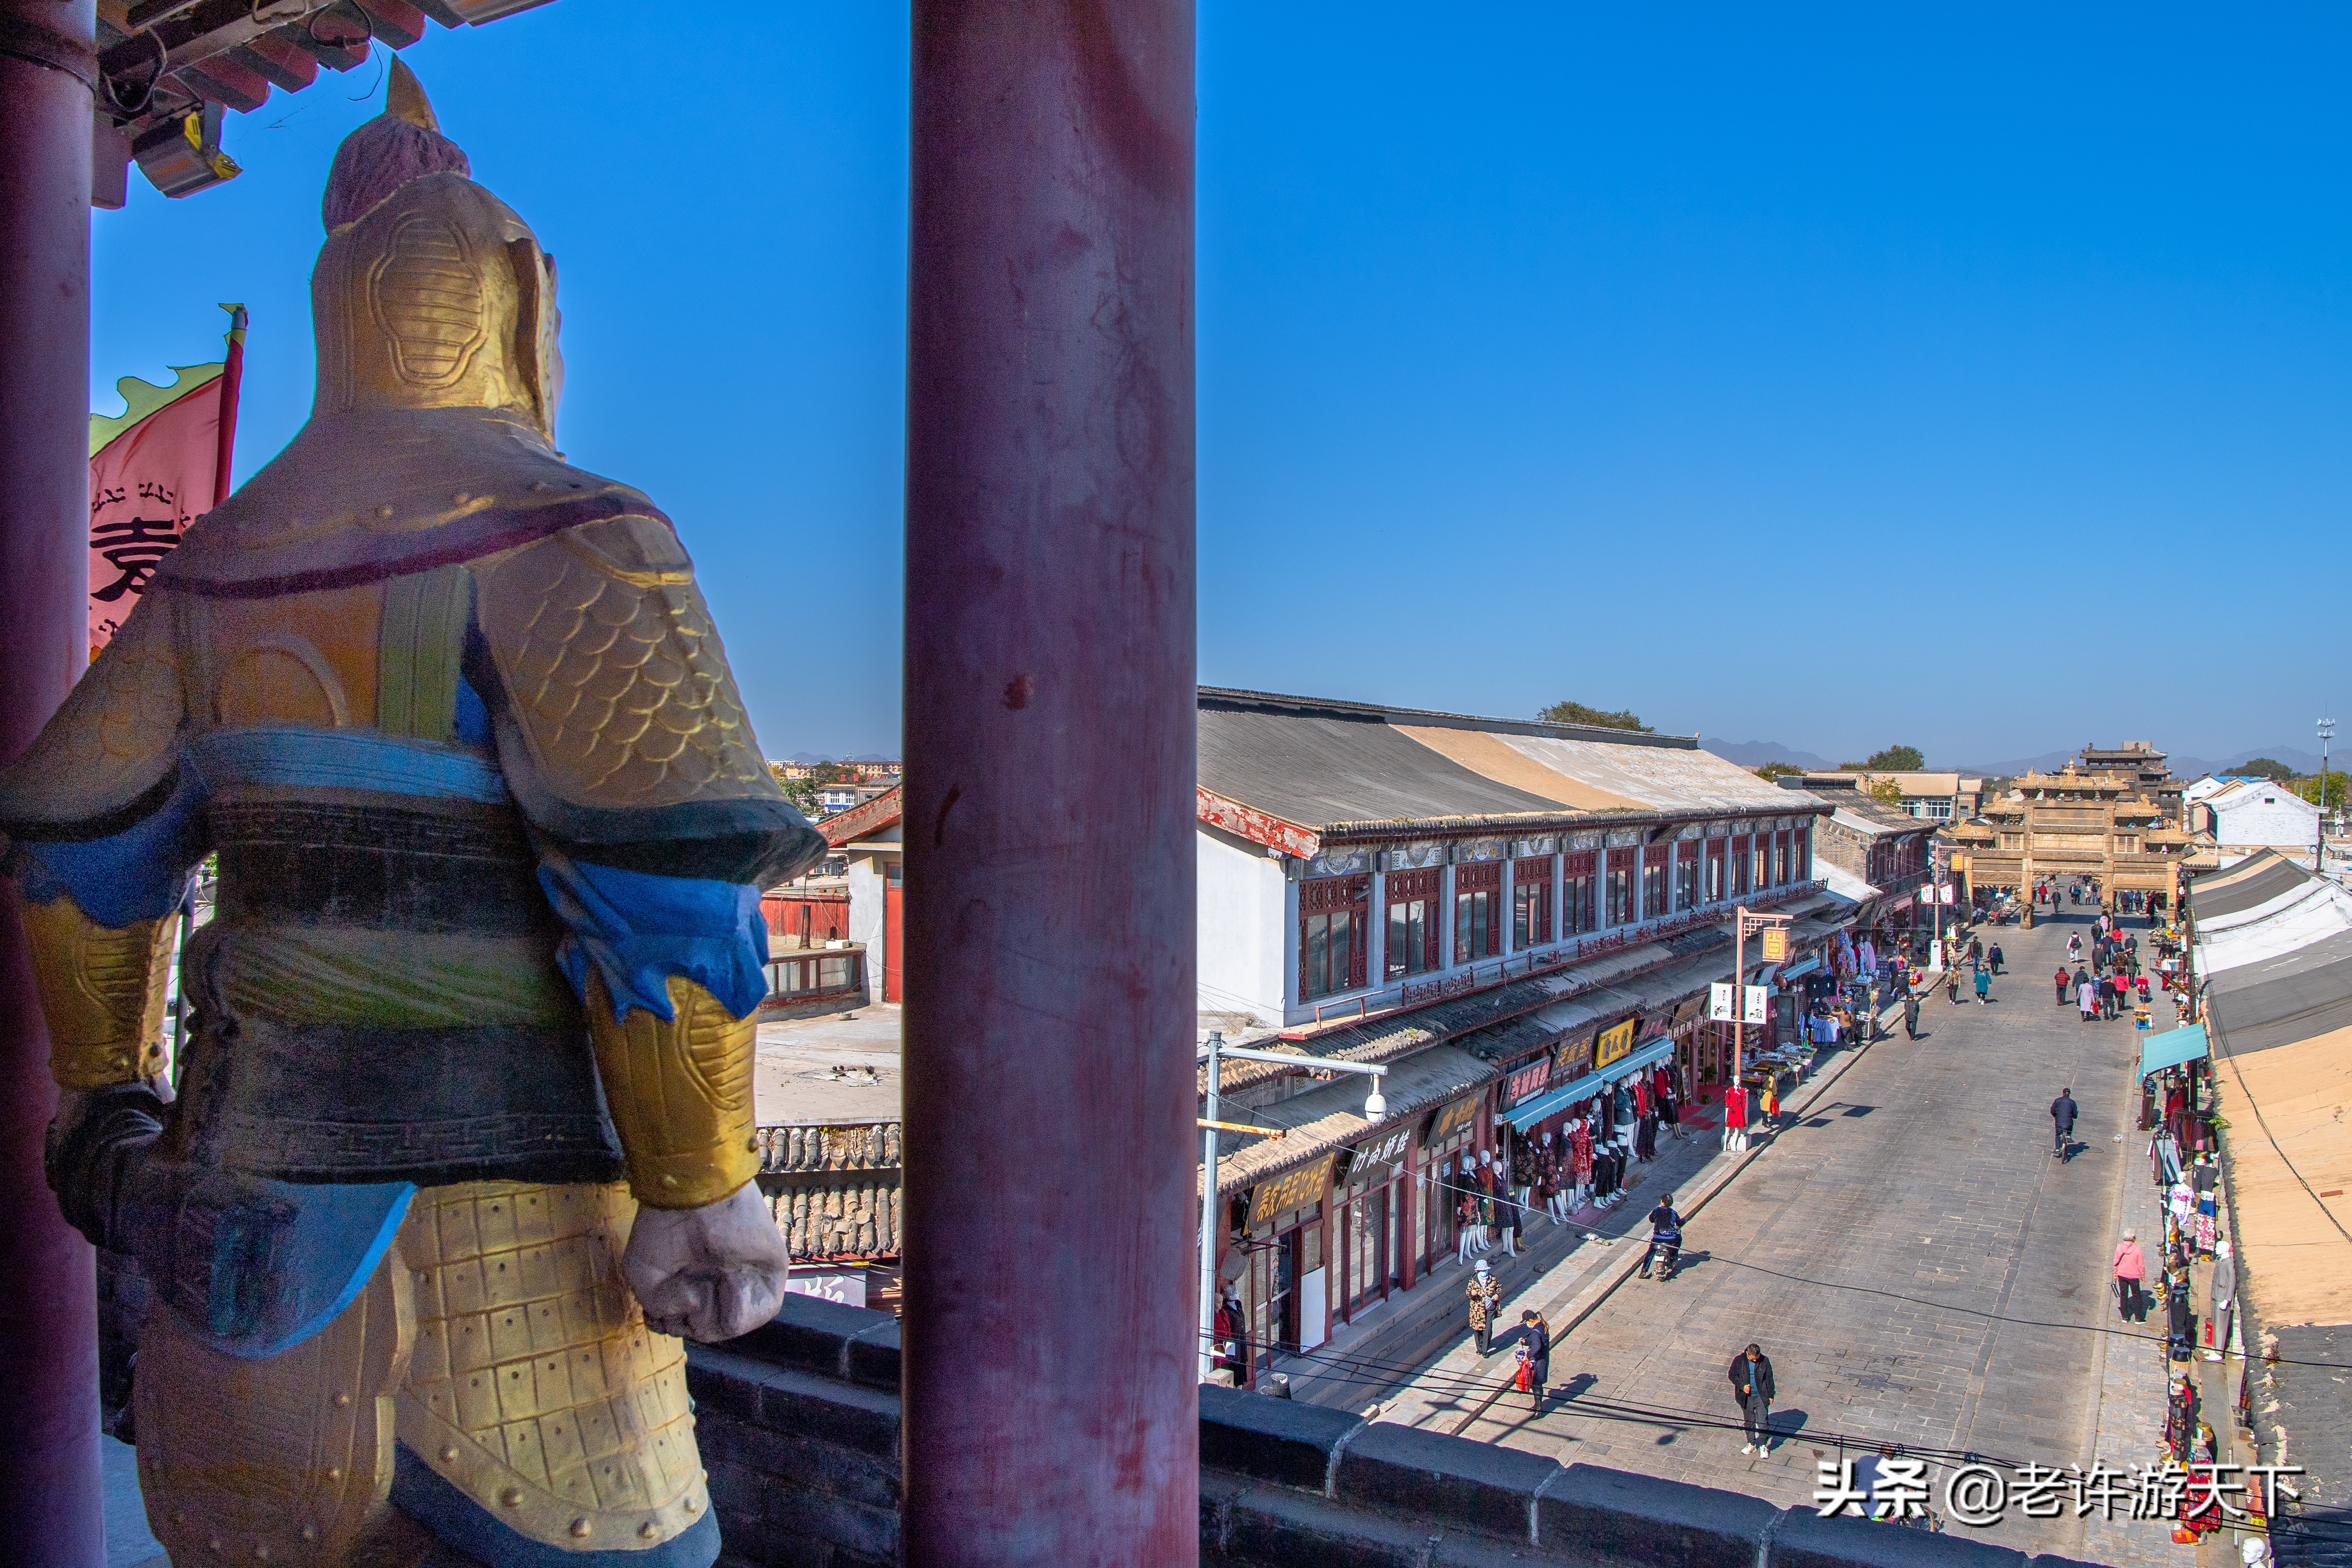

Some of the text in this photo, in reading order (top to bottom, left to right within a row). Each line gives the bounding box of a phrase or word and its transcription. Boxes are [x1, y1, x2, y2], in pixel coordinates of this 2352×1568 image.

[1256, 1159, 1329, 1223] 美发用品化妆品
